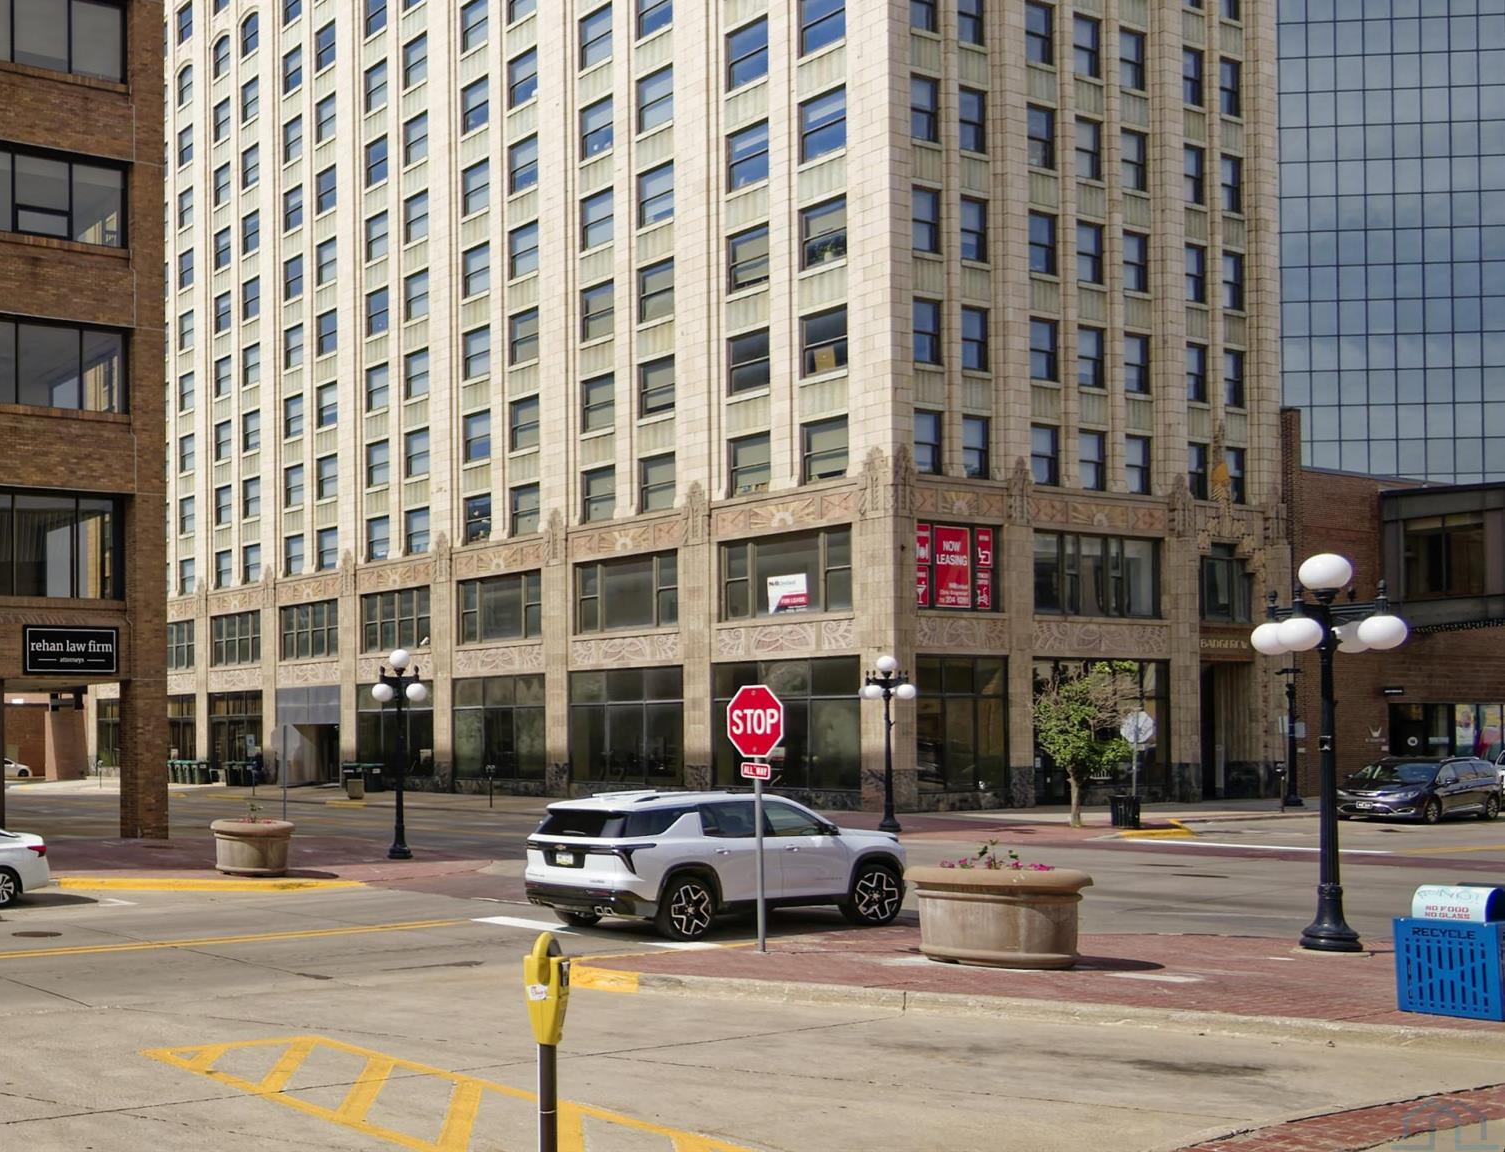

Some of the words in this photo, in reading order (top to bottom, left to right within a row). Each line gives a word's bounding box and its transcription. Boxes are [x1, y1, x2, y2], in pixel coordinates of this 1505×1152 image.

[943, 541, 961, 551] NOW
[936, 554, 967, 566] LEASING
[30, 639, 64, 651] rehan
[66, 640, 86, 652] law
[88, 640, 112, 652] firm
[732, 708, 779, 735] STOP
[743, 766, 754, 775] ALL
[755, 767, 767, 776] WAY
[1440, 905, 1469, 913] FOOD
[1412, 927, 1476, 940] RECYCLE
